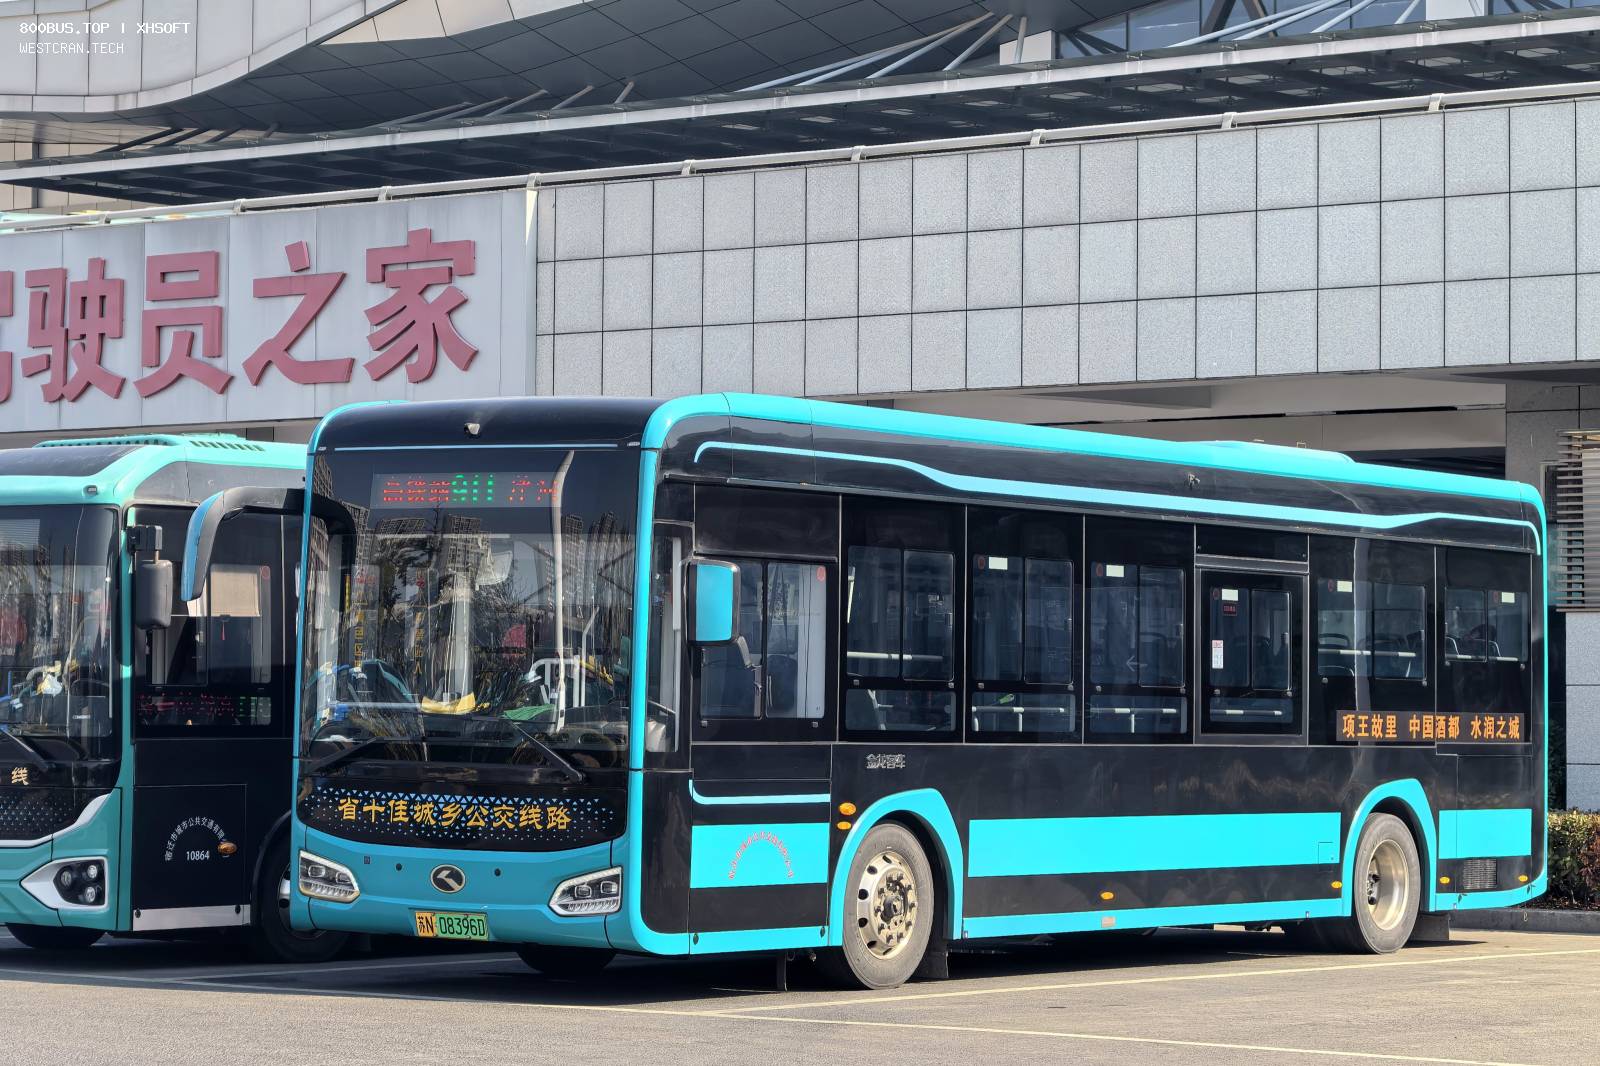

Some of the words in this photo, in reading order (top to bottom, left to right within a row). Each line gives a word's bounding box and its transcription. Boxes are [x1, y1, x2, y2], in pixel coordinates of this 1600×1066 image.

[0, 228, 480, 403] 驶员之家
[1342, 714, 1398, 739] 项王故里
[1409, 714, 1460, 740] 中国酒都
[337, 797, 572, 831] 省十佳城乡公交线路
[186, 850, 210, 861] 10864
